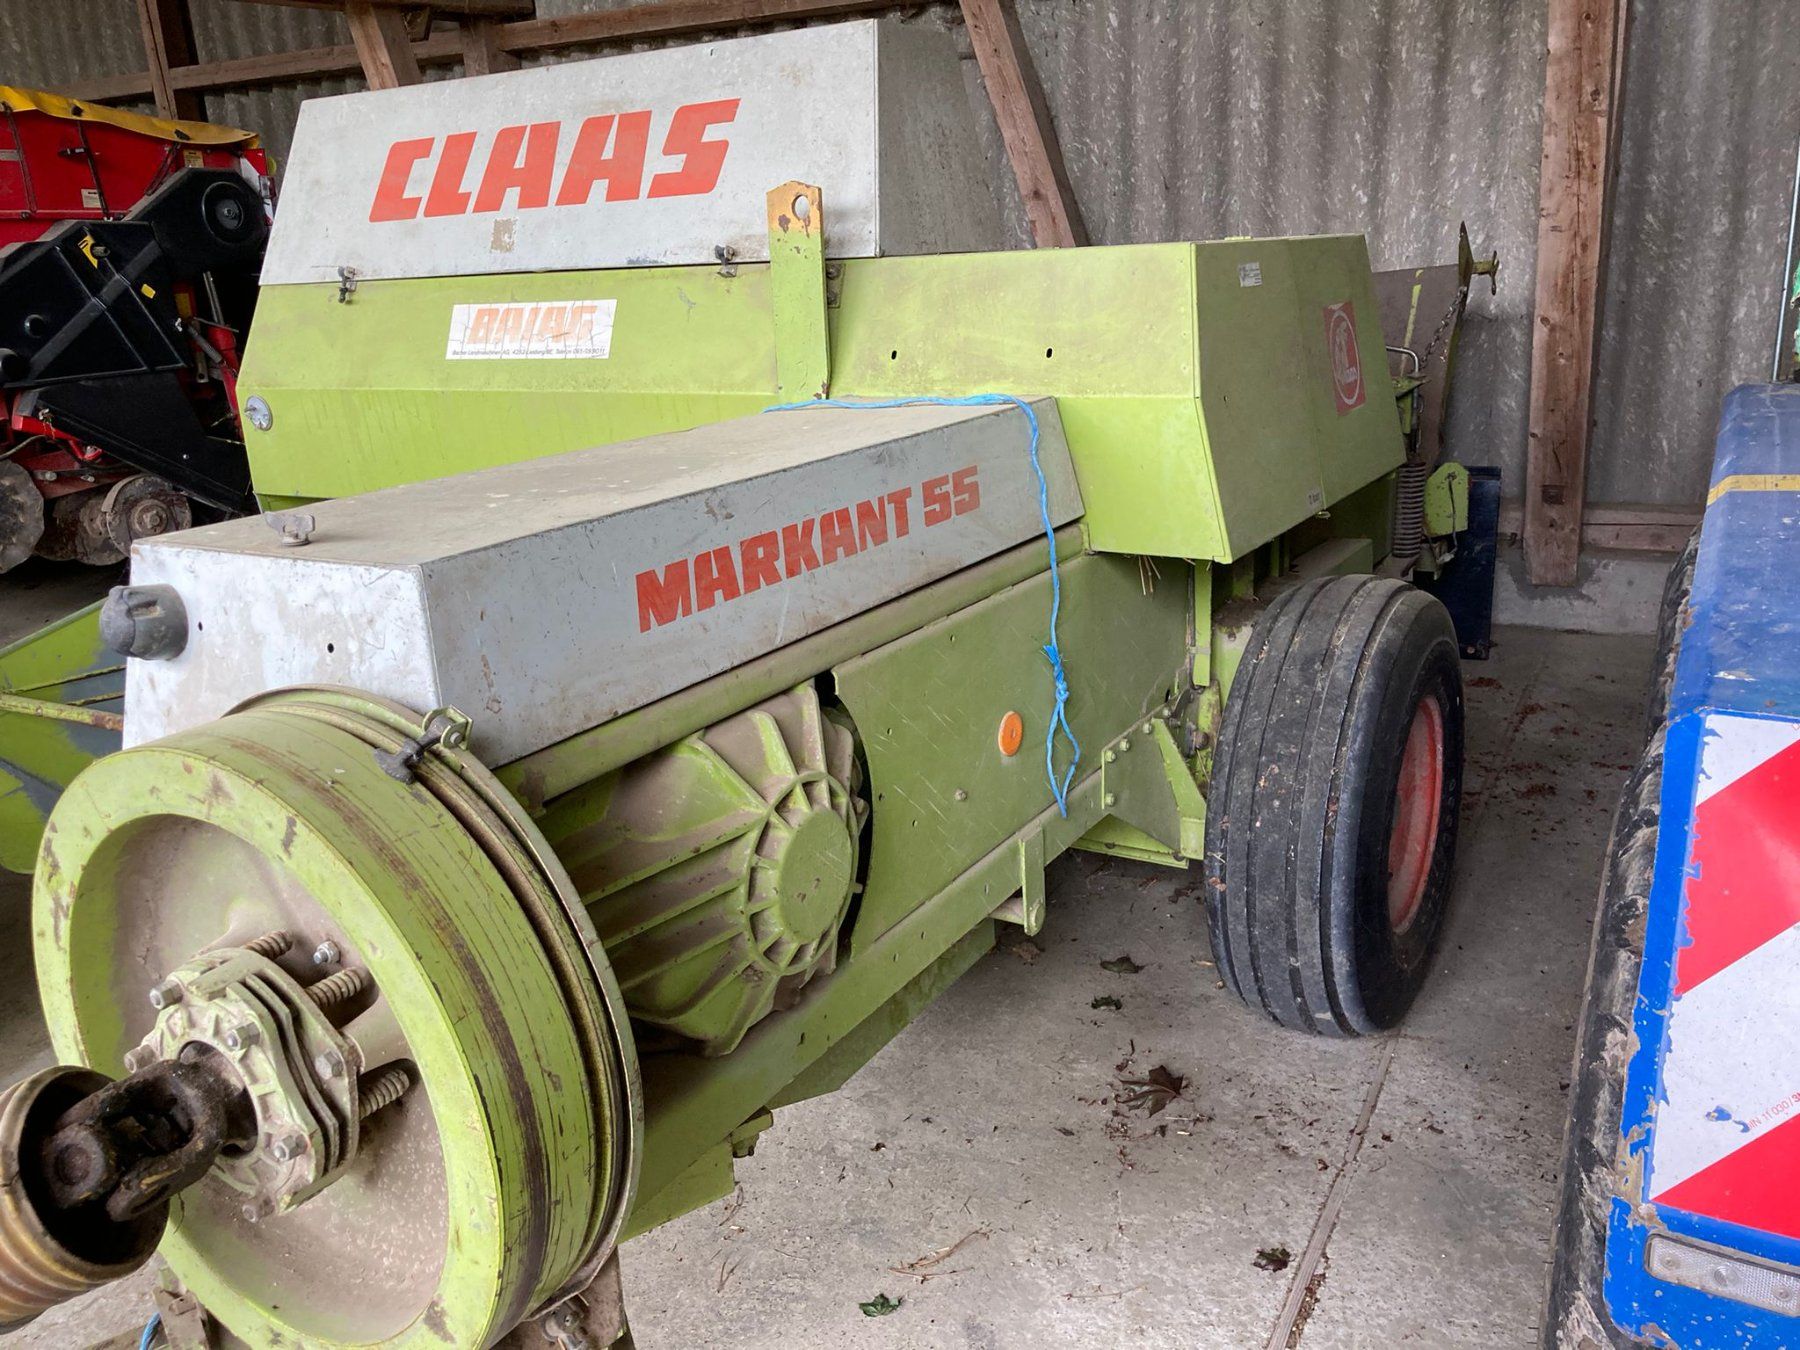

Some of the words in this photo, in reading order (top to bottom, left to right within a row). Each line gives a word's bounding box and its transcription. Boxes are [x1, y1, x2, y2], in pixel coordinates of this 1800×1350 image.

[369, 98, 741, 223] CLAAS
[635, 487, 912, 634] MARKANT
[922, 465, 981, 528] 55
